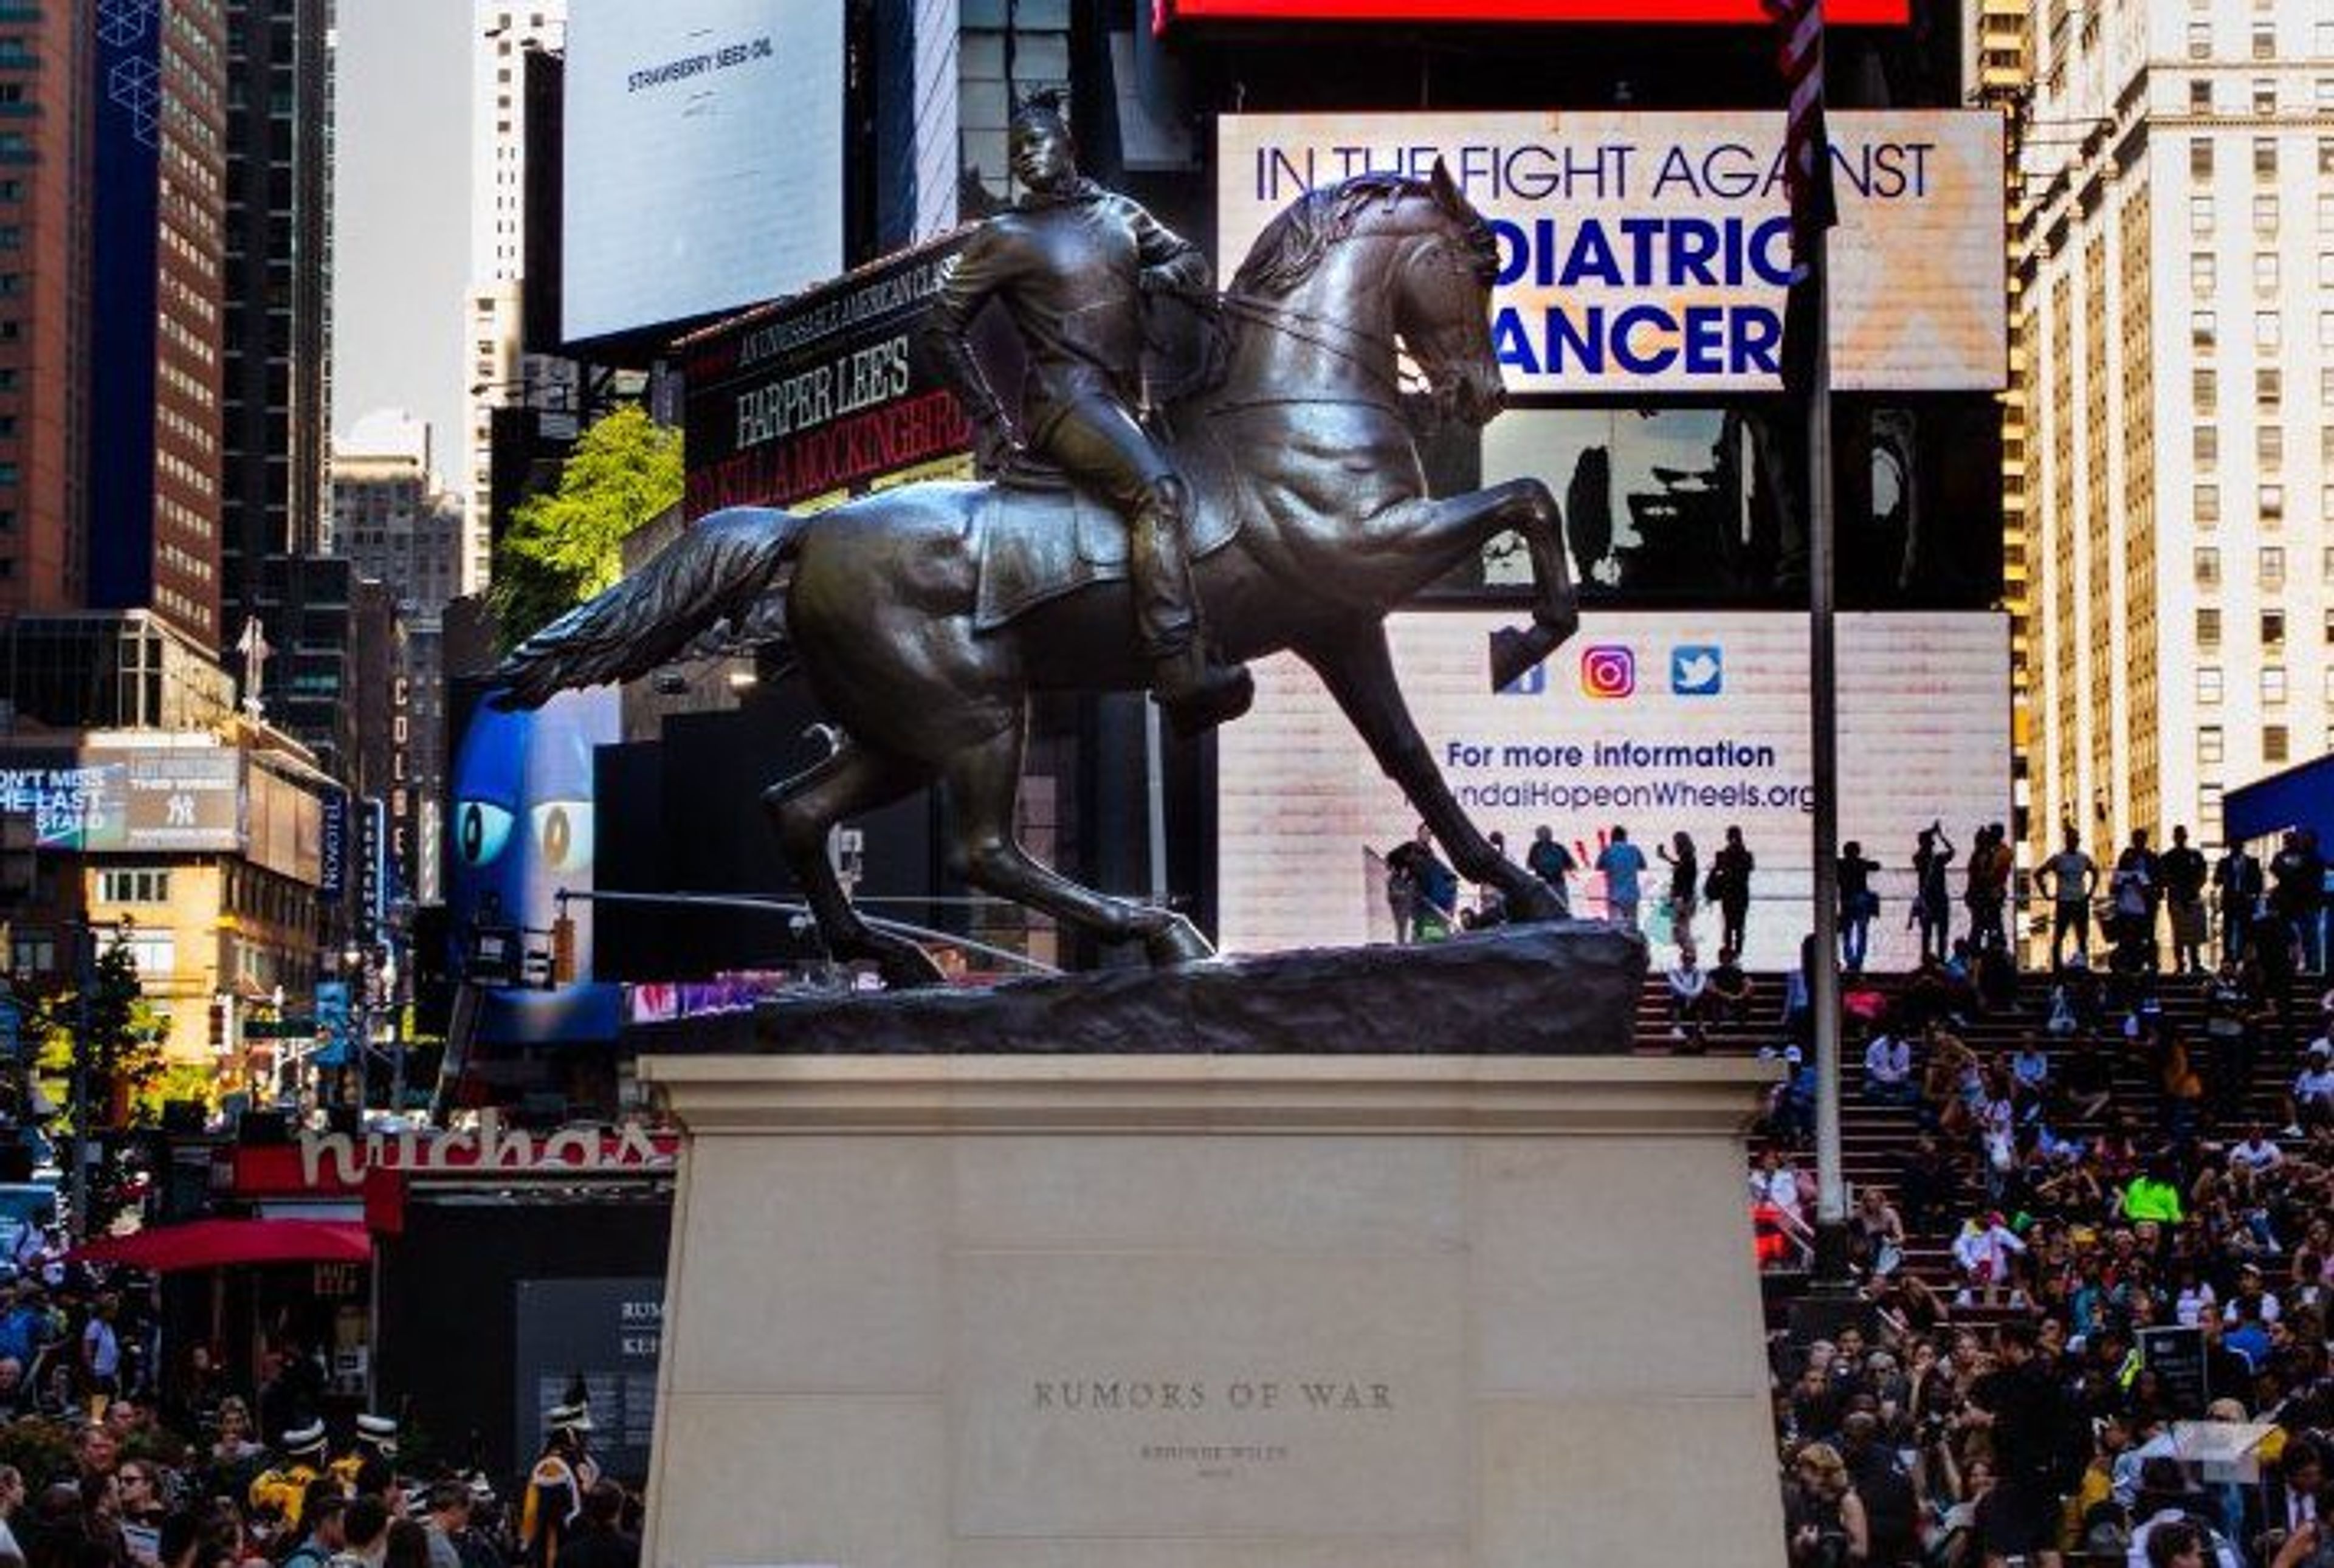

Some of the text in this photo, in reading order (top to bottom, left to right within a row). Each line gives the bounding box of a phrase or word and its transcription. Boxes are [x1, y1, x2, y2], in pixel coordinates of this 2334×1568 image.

[1257, 143, 1936, 201] IN THE FIGHT AGANST
[1492, 304, 1781, 375] ANCER
[736, 335, 909, 450] HARPER LEE'S
[392, 676, 408, 875] COLBE
[1447, 740, 1775, 768] For more information
[36, 789, 106, 810] LAST
[1033, 1382, 1394, 1410] RUMORS OF WAR
